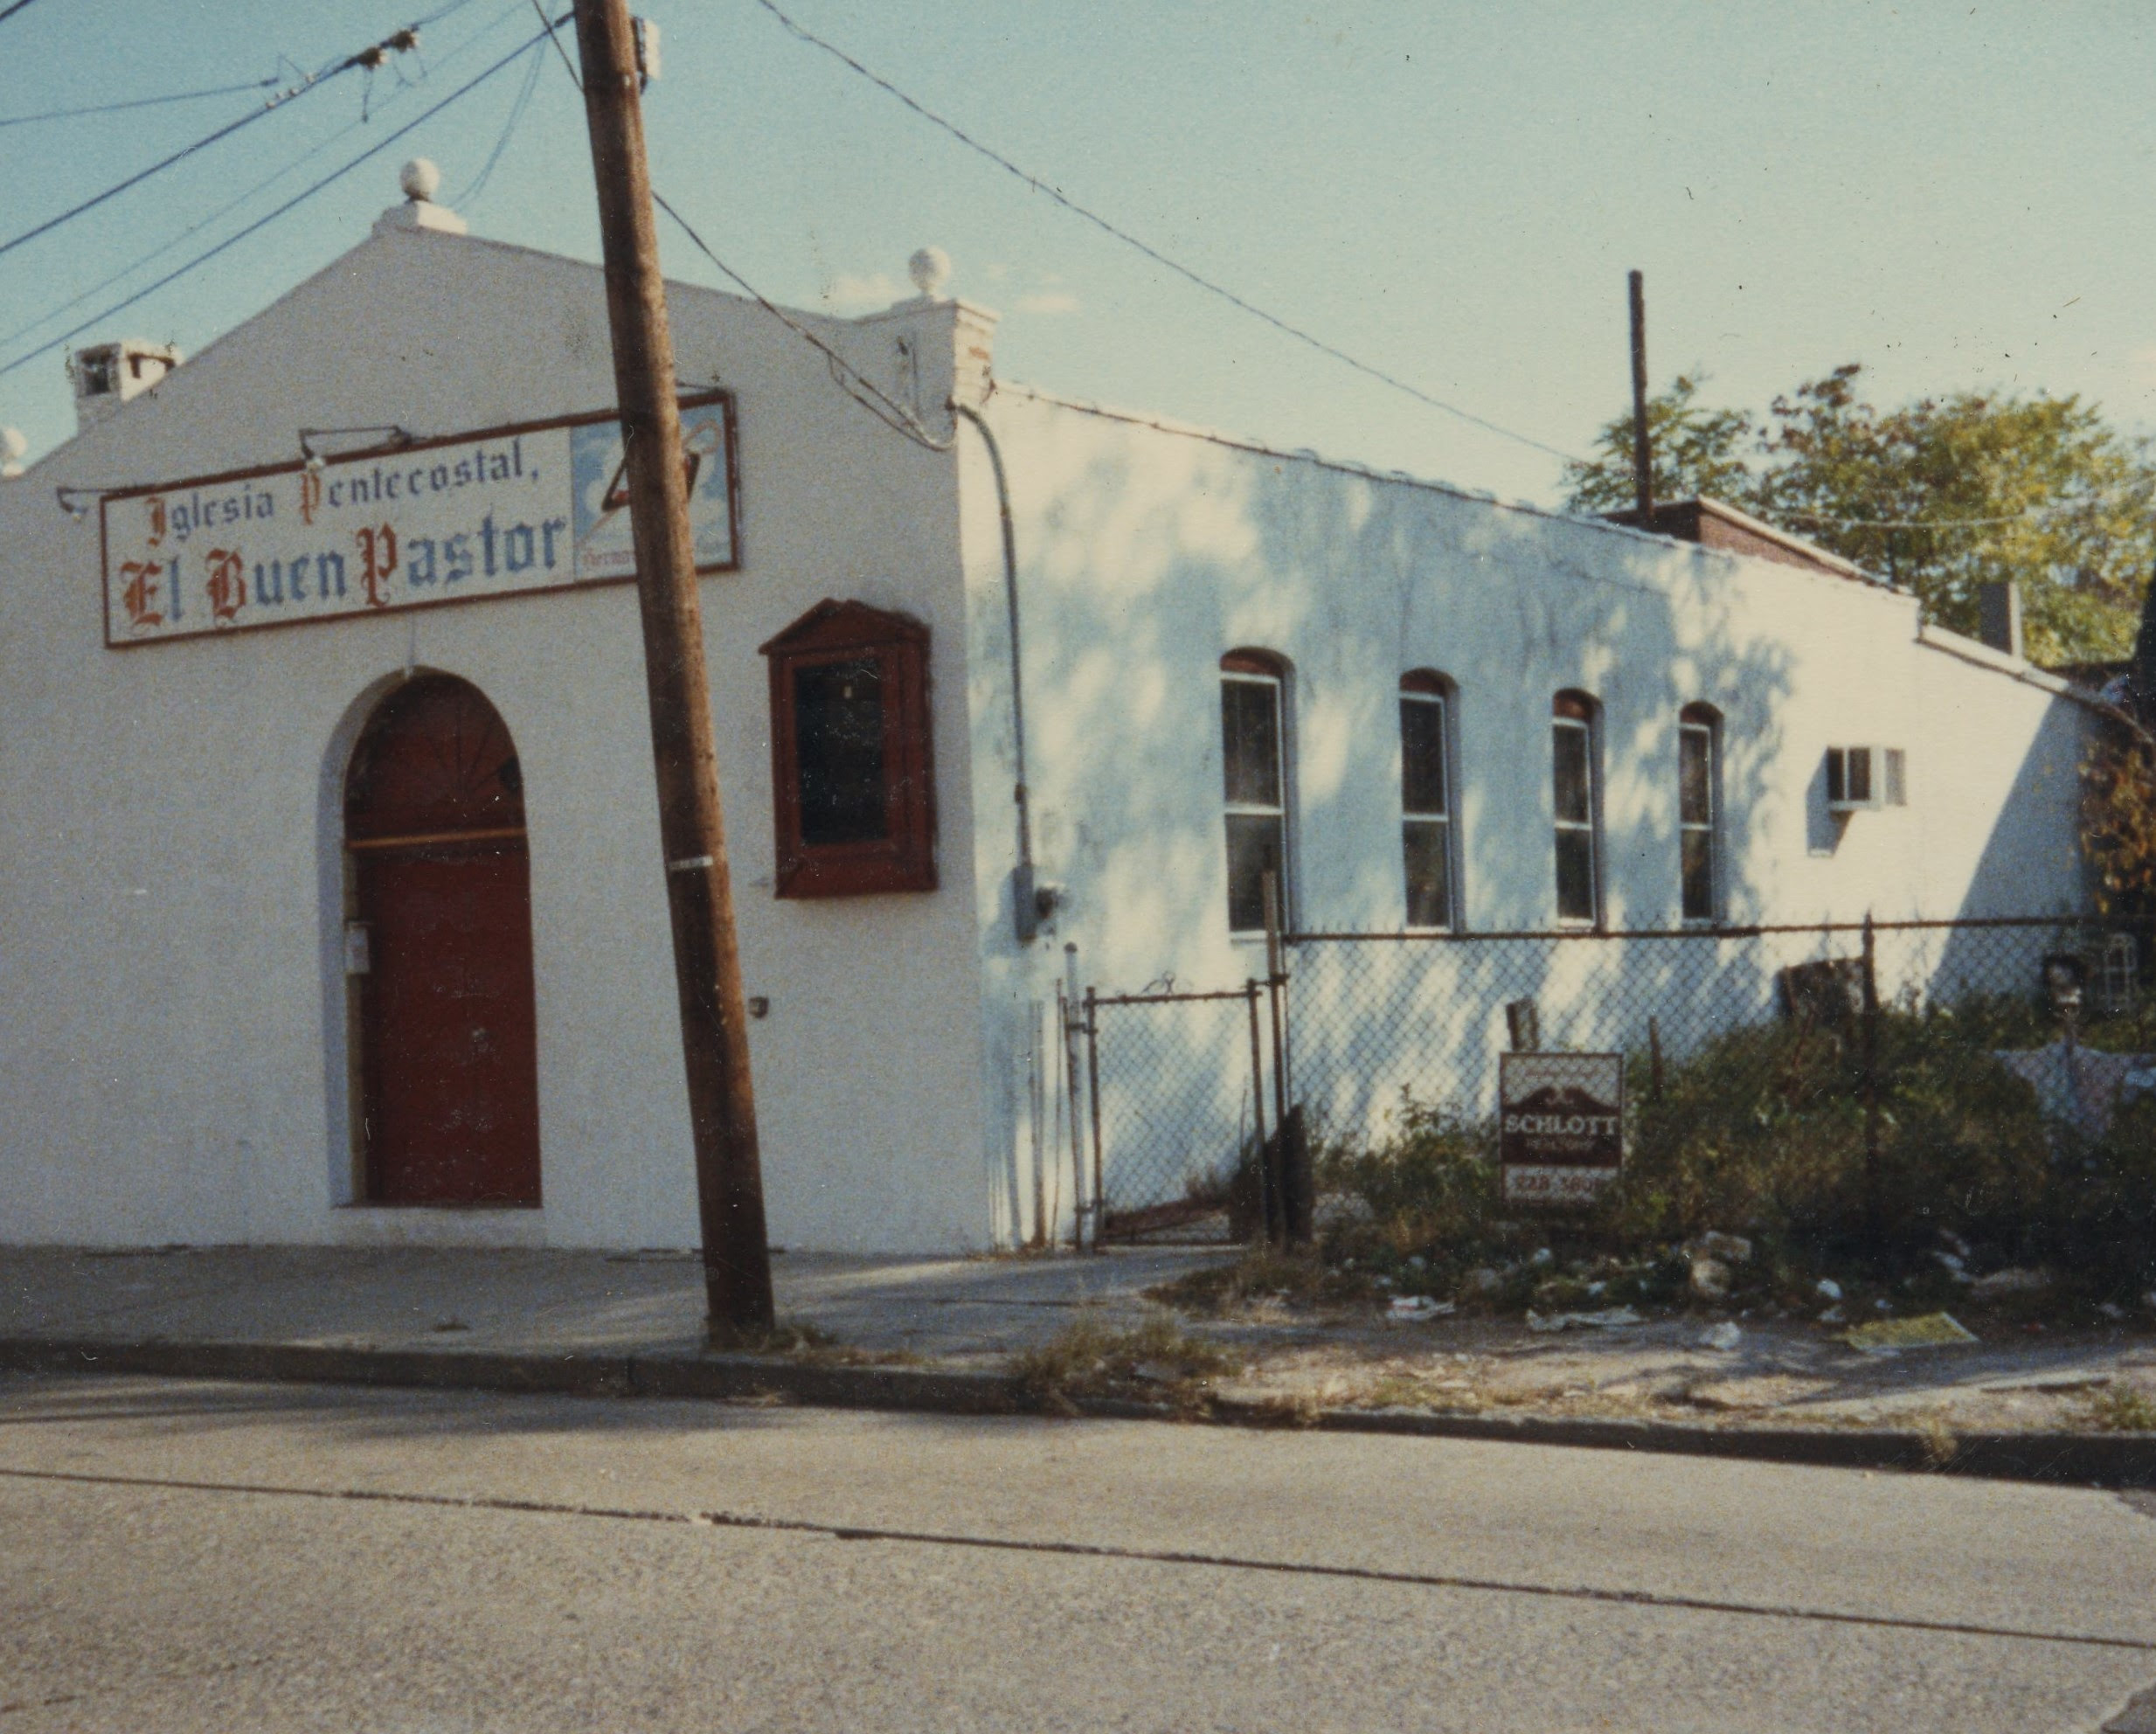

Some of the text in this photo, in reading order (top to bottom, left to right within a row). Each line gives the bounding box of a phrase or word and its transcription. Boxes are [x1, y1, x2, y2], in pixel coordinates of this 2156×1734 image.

[145, 437, 539, 547] Iglesia Pentecostal,
[120, 507, 566, 627] El Buen Pastor
[1505, 1113, 1617, 1135] SCHLOTT
